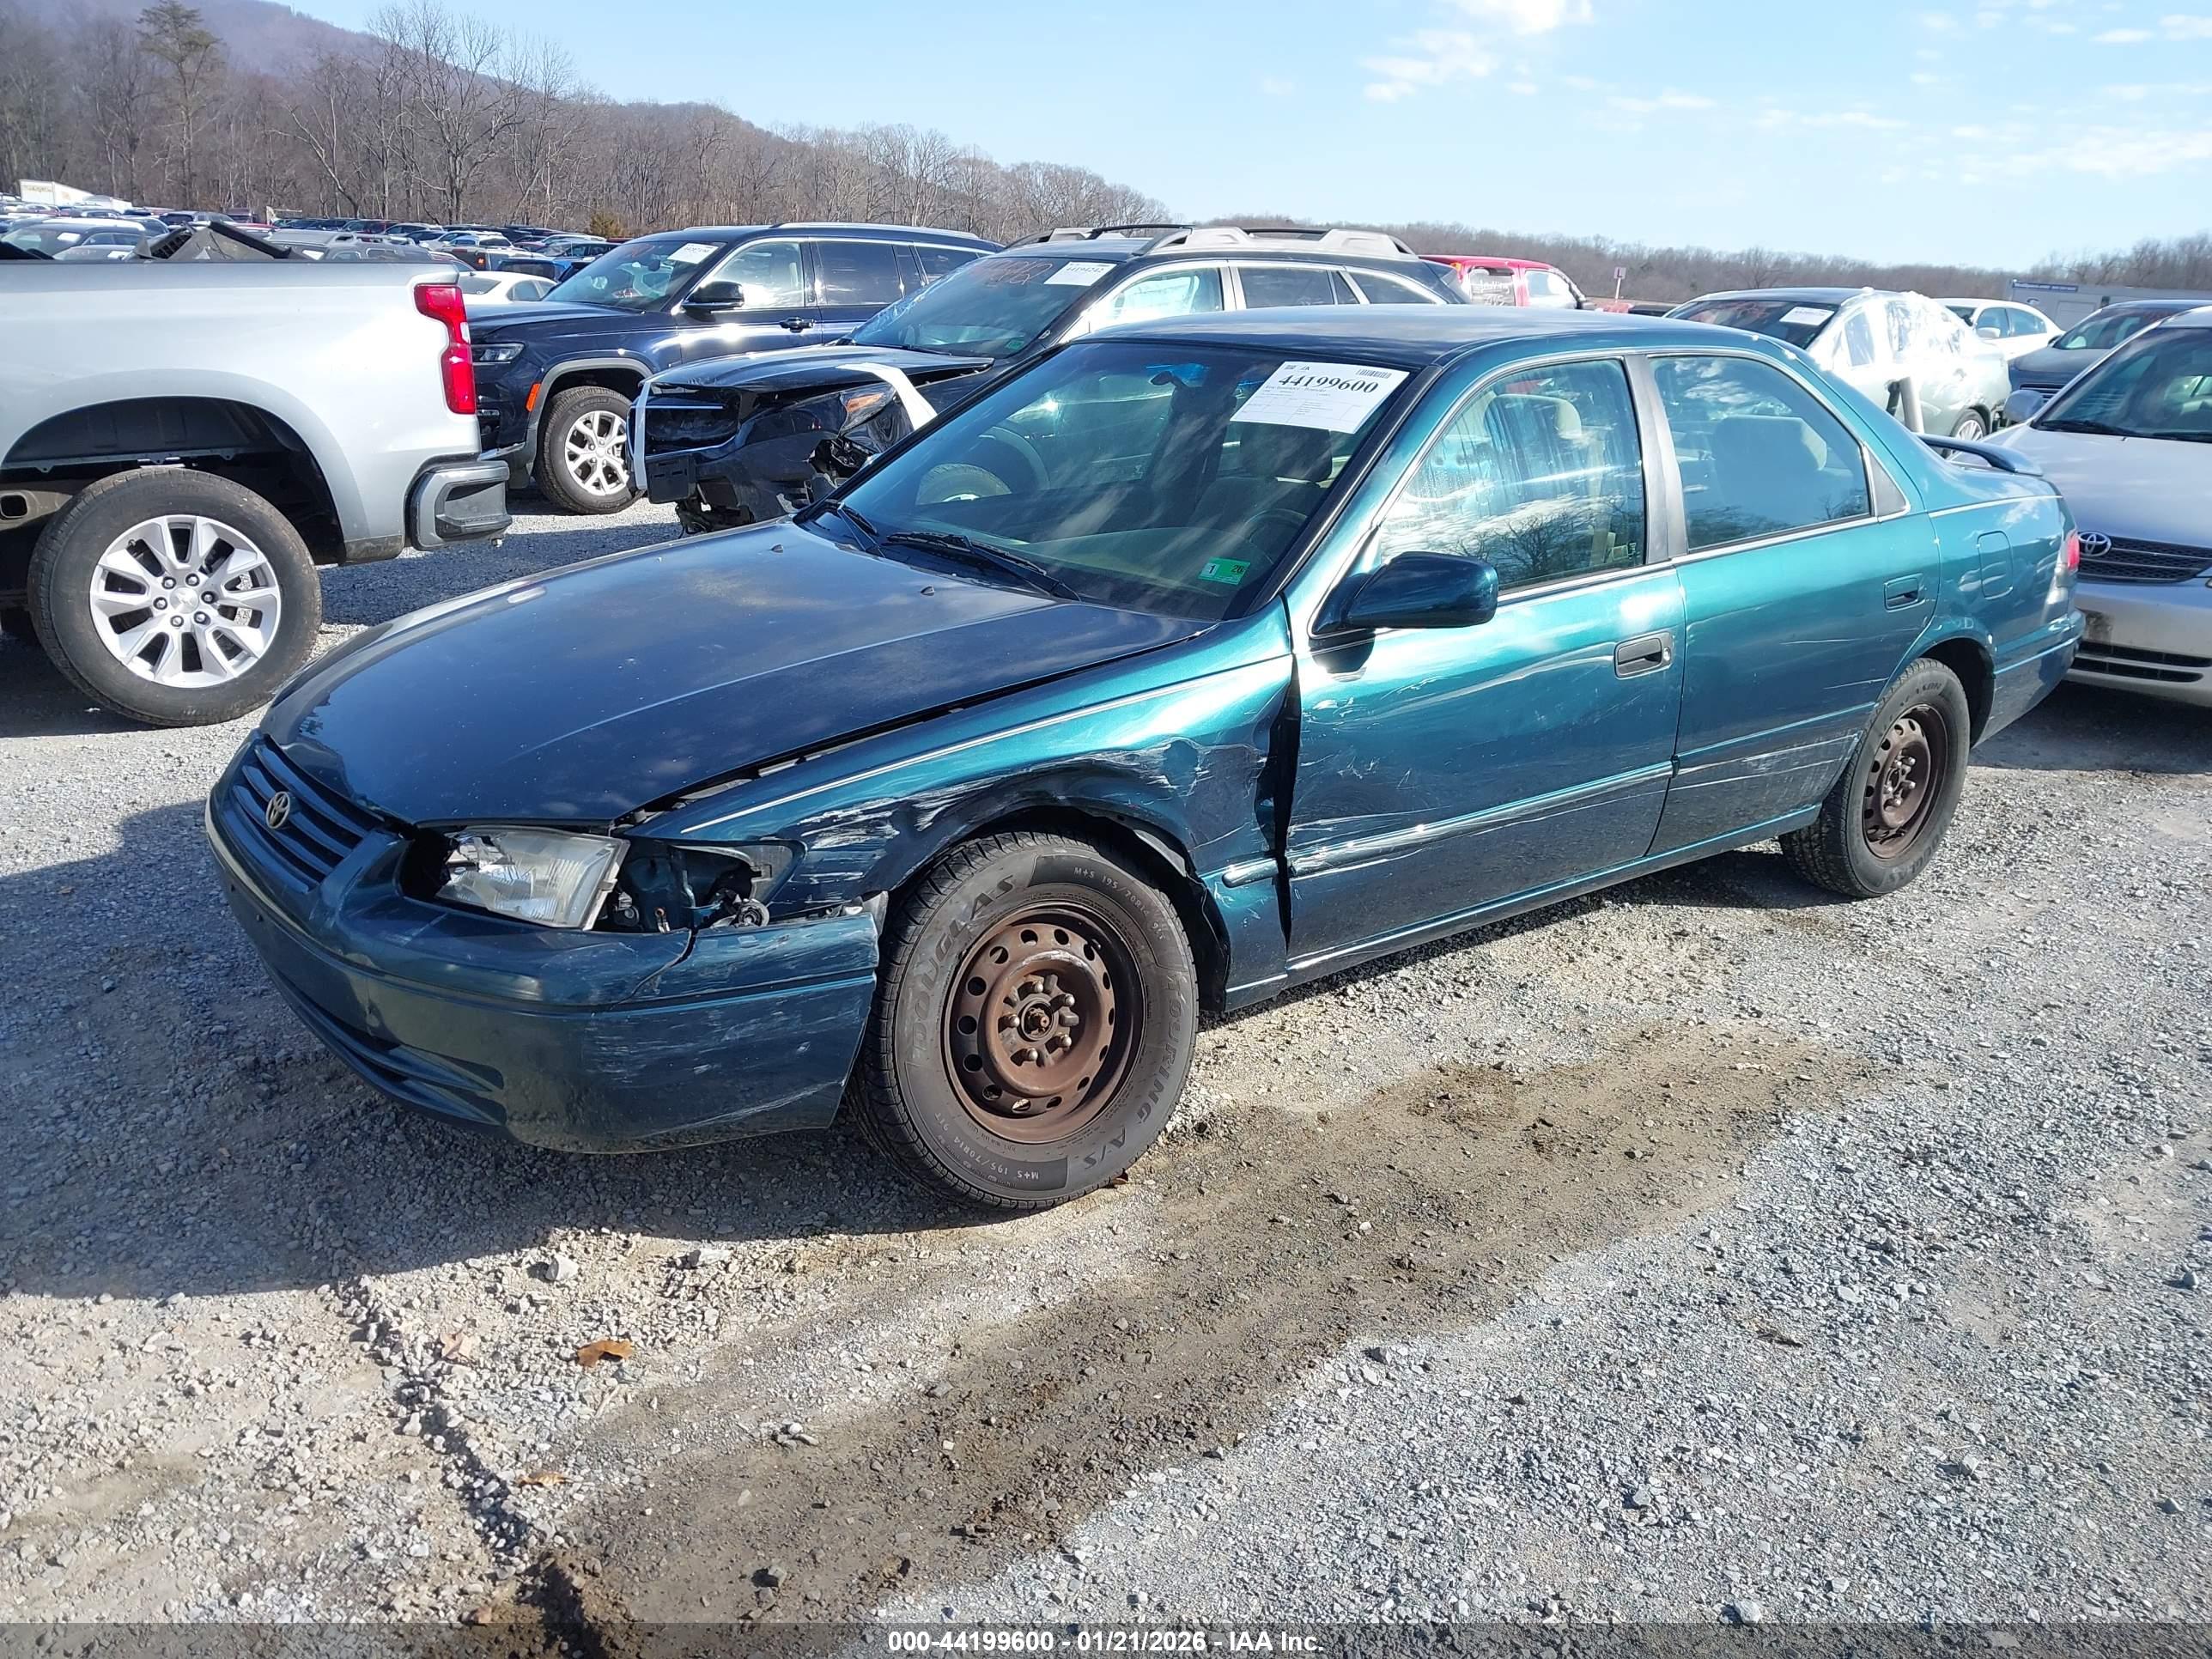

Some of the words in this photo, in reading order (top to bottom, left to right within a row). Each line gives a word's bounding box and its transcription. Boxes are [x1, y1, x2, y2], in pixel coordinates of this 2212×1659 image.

[1278, 374, 1379, 393] 44199600
[1208, 564, 1216, 574] 1
[1073, 866, 1096, 878] M+S
[912, 874, 1014, 1053] DOUGLAS
[1135, 974, 1186, 1124] TOURING
[933, 1111, 950, 1132] 91T
[952, 1135, 1009, 1176] 195/70R14
[1083, 1125, 1127, 1170] A/S
[1016, 1169, 1040, 1181] M+S
